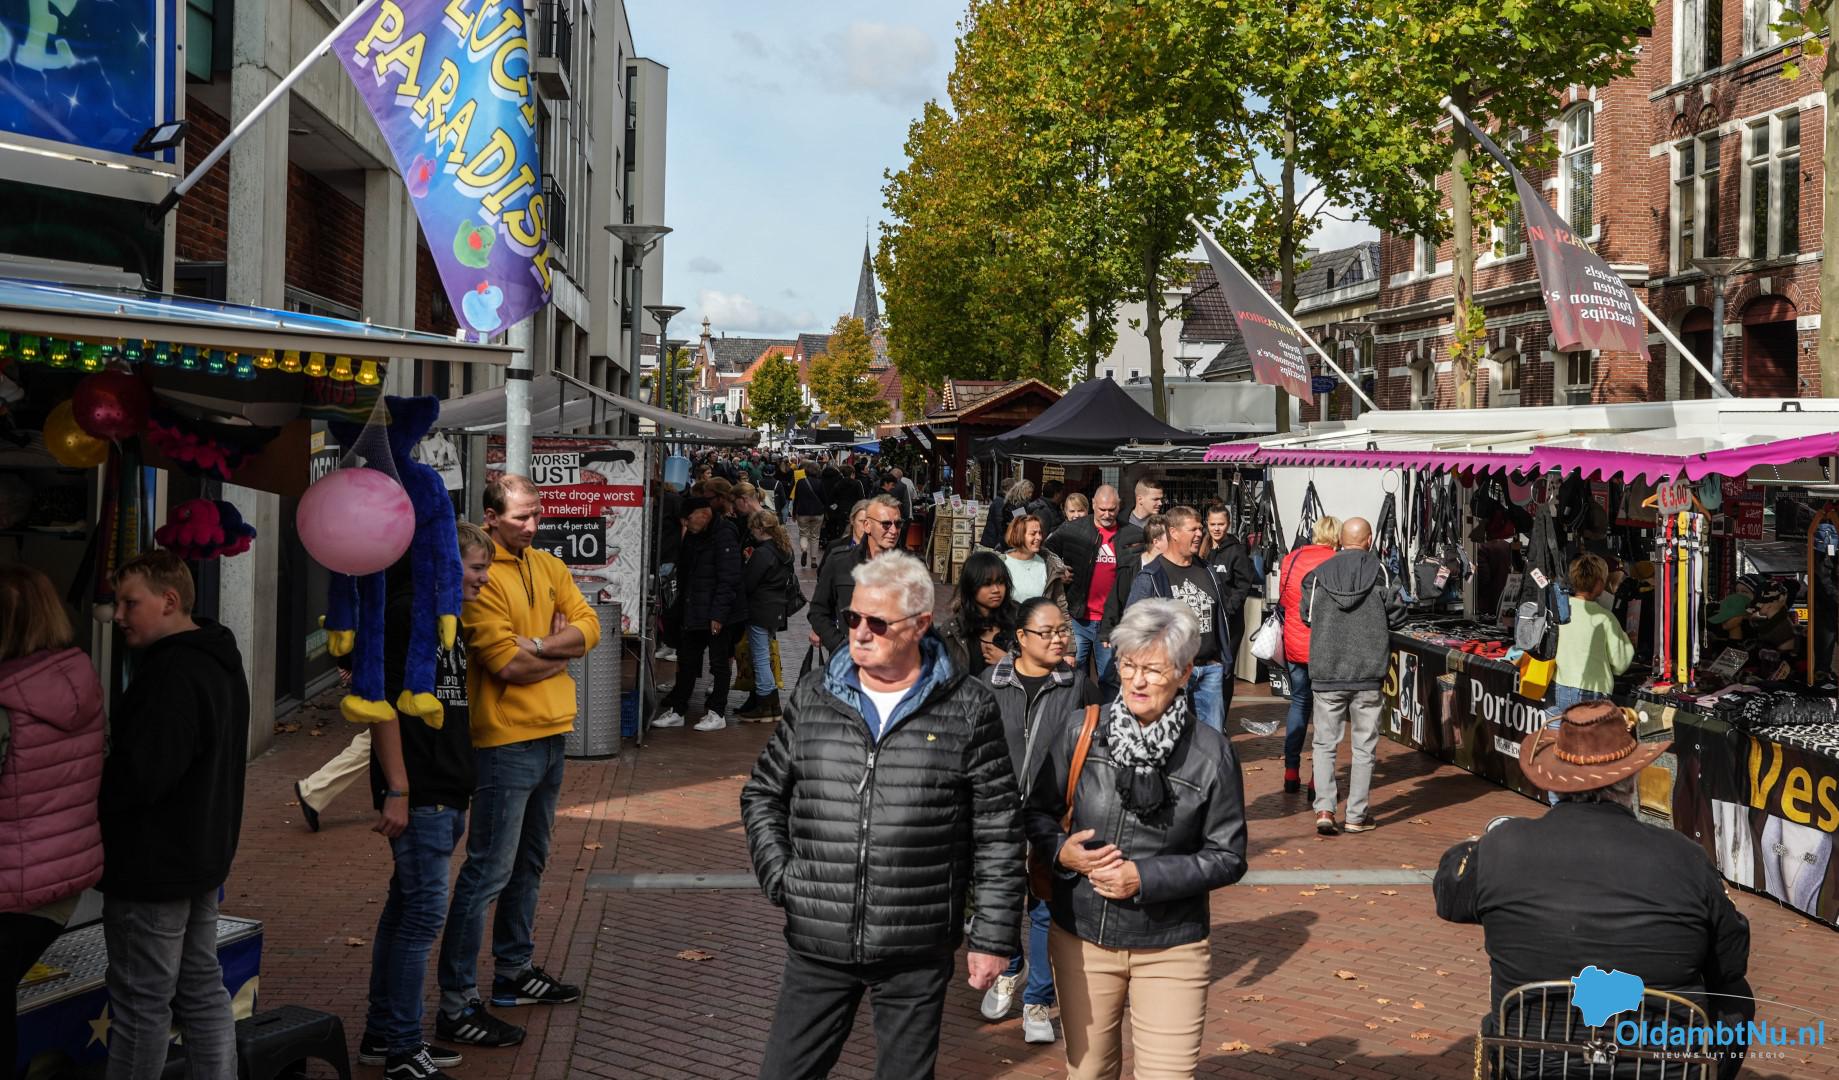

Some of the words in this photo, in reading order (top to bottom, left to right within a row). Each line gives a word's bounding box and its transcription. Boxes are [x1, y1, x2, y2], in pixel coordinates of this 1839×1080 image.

[354, 0, 551, 298] PARADIS
[532, 466, 578, 484] UST
[539, 489, 567, 500] erste
[568, 490, 600, 503] droge
[603, 491, 635, 501] worst
[1669, 484, 1688, 506] 5,00
[548, 504, 592, 517] makerij!
[571, 524, 582, 533] per
[583, 523, 600, 531] stuk
[566, 533, 598, 558] 10
[1470, 678, 1547, 735] Portom
[1749, 735, 1839, 833] Ves
